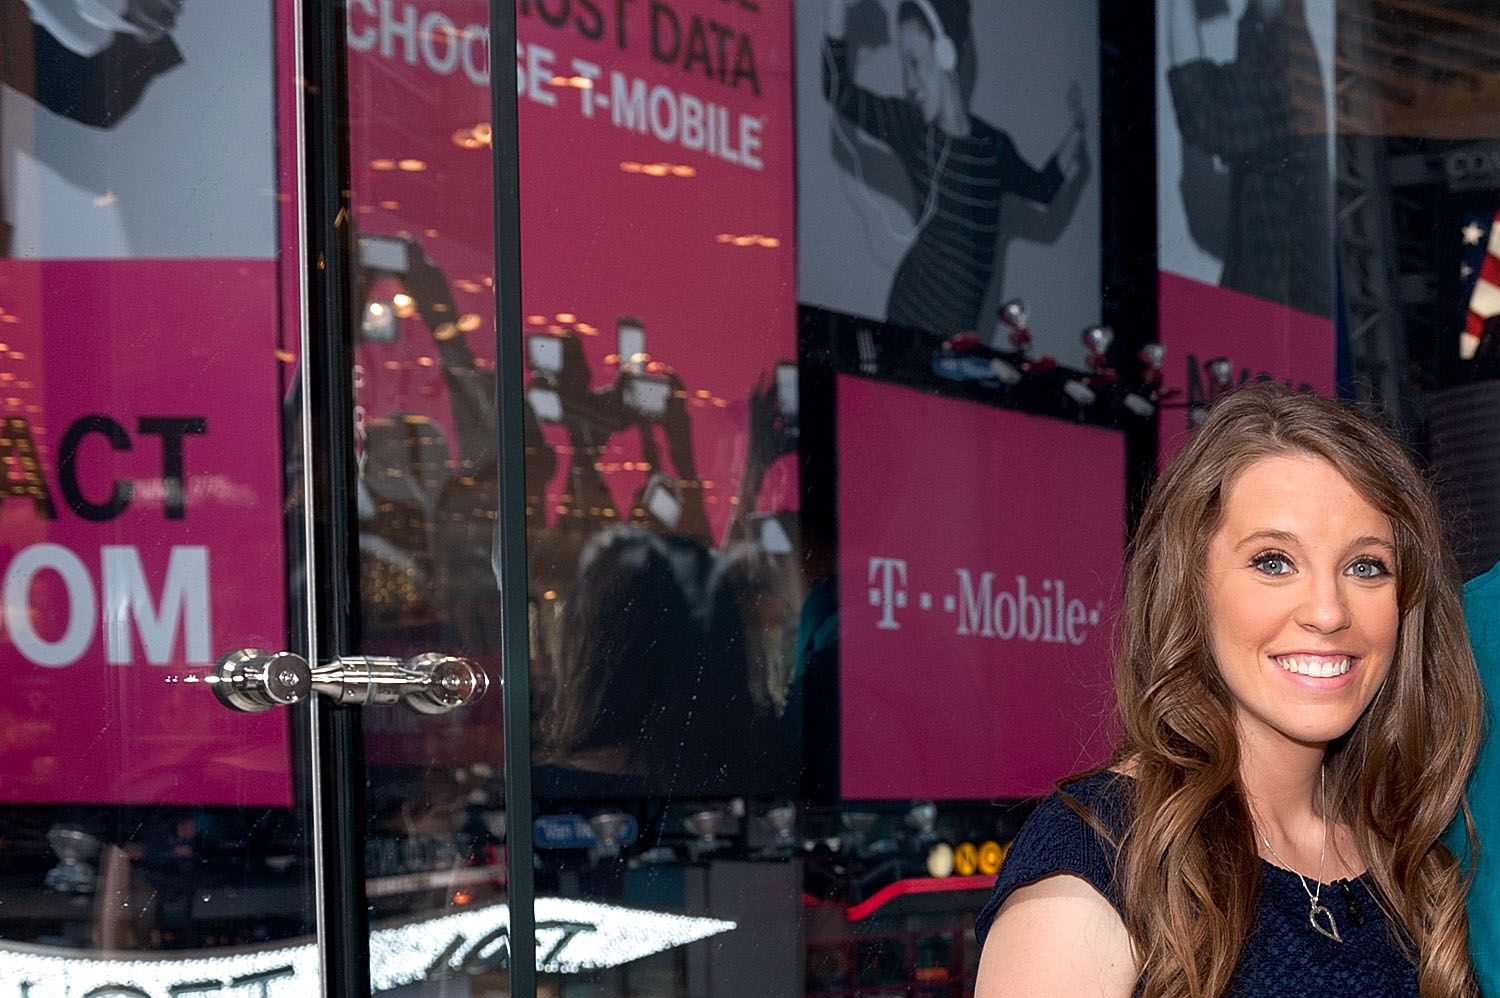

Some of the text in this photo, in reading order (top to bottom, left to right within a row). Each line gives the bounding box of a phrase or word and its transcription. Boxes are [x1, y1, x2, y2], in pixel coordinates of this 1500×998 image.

[521, 0, 761, 97] OST DATA
[571, 57, 766, 171] T-MOBILE
[1, 542, 214, 668] OM
[425, 920, 598, 977] LOT
